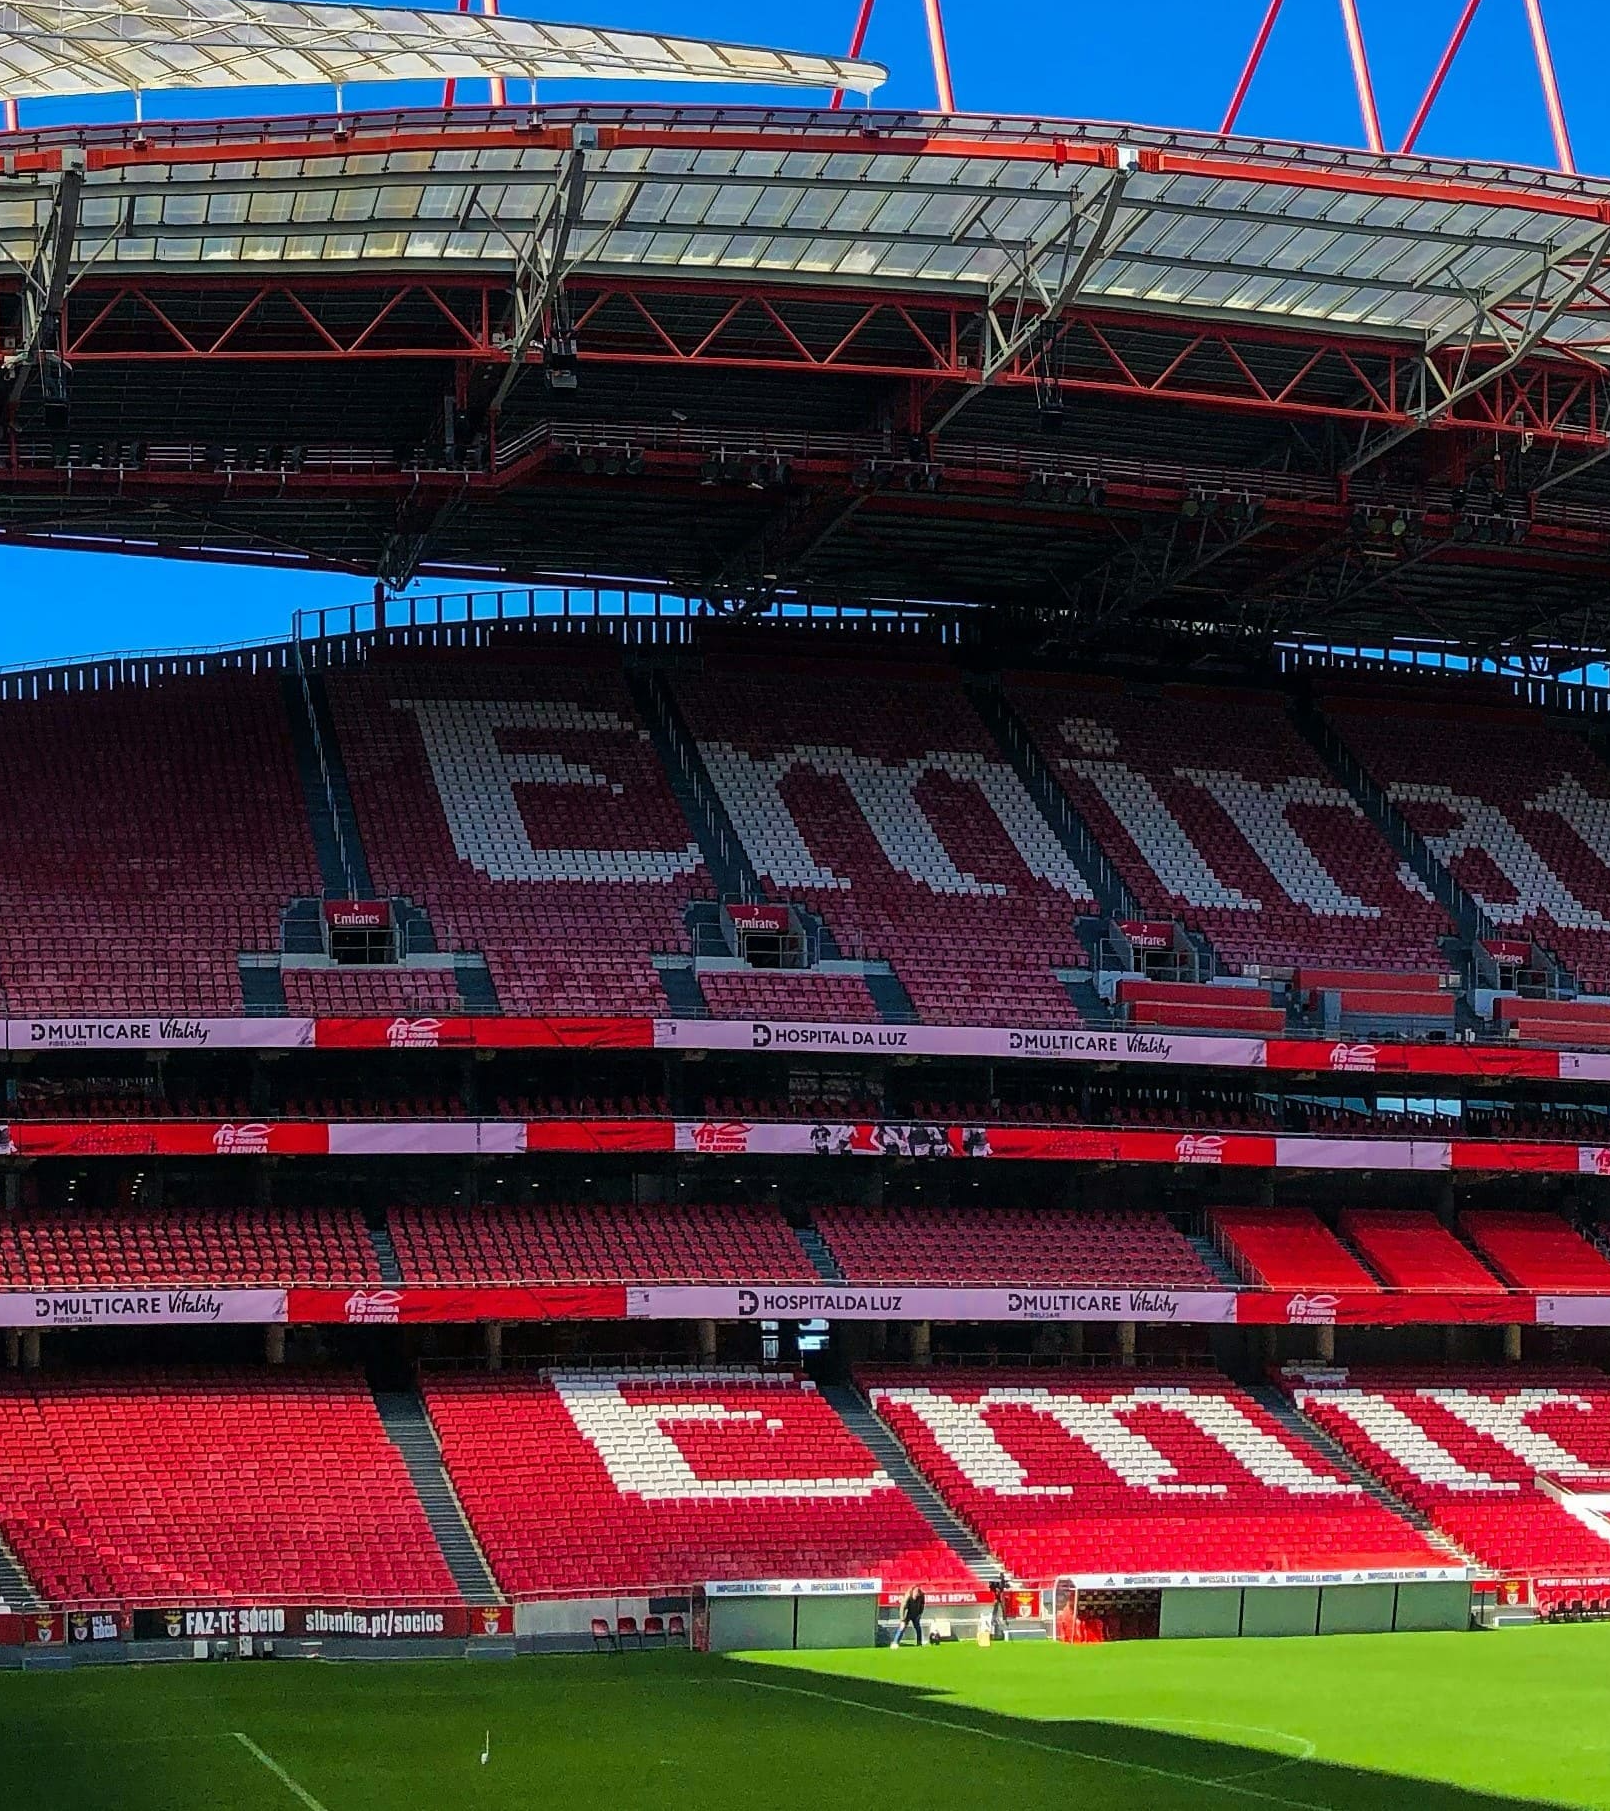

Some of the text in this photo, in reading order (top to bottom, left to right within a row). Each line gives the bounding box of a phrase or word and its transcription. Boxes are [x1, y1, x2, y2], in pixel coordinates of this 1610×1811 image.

[334, 912, 379, 926] Emirates
[735, 916, 779, 930] Emirates
[1490, 953, 1524, 966] mirates
[49, 1019, 211, 1044] MULTICARE Vitality
[776, 1029, 907, 1045] HOSPITAL DA LUZ
[1025, 1033, 1172, 1060] MULTICARE Vitality
[53, 1291, 223, 1320] MULTICARE Vitality
[764, 1295, 902, 1310] HOSPITAL DA LUZ
[1024, 1291, 1179, 1318] MULTICARE Vitality
[186, 1610, 235, 1635] FAZ-TE
